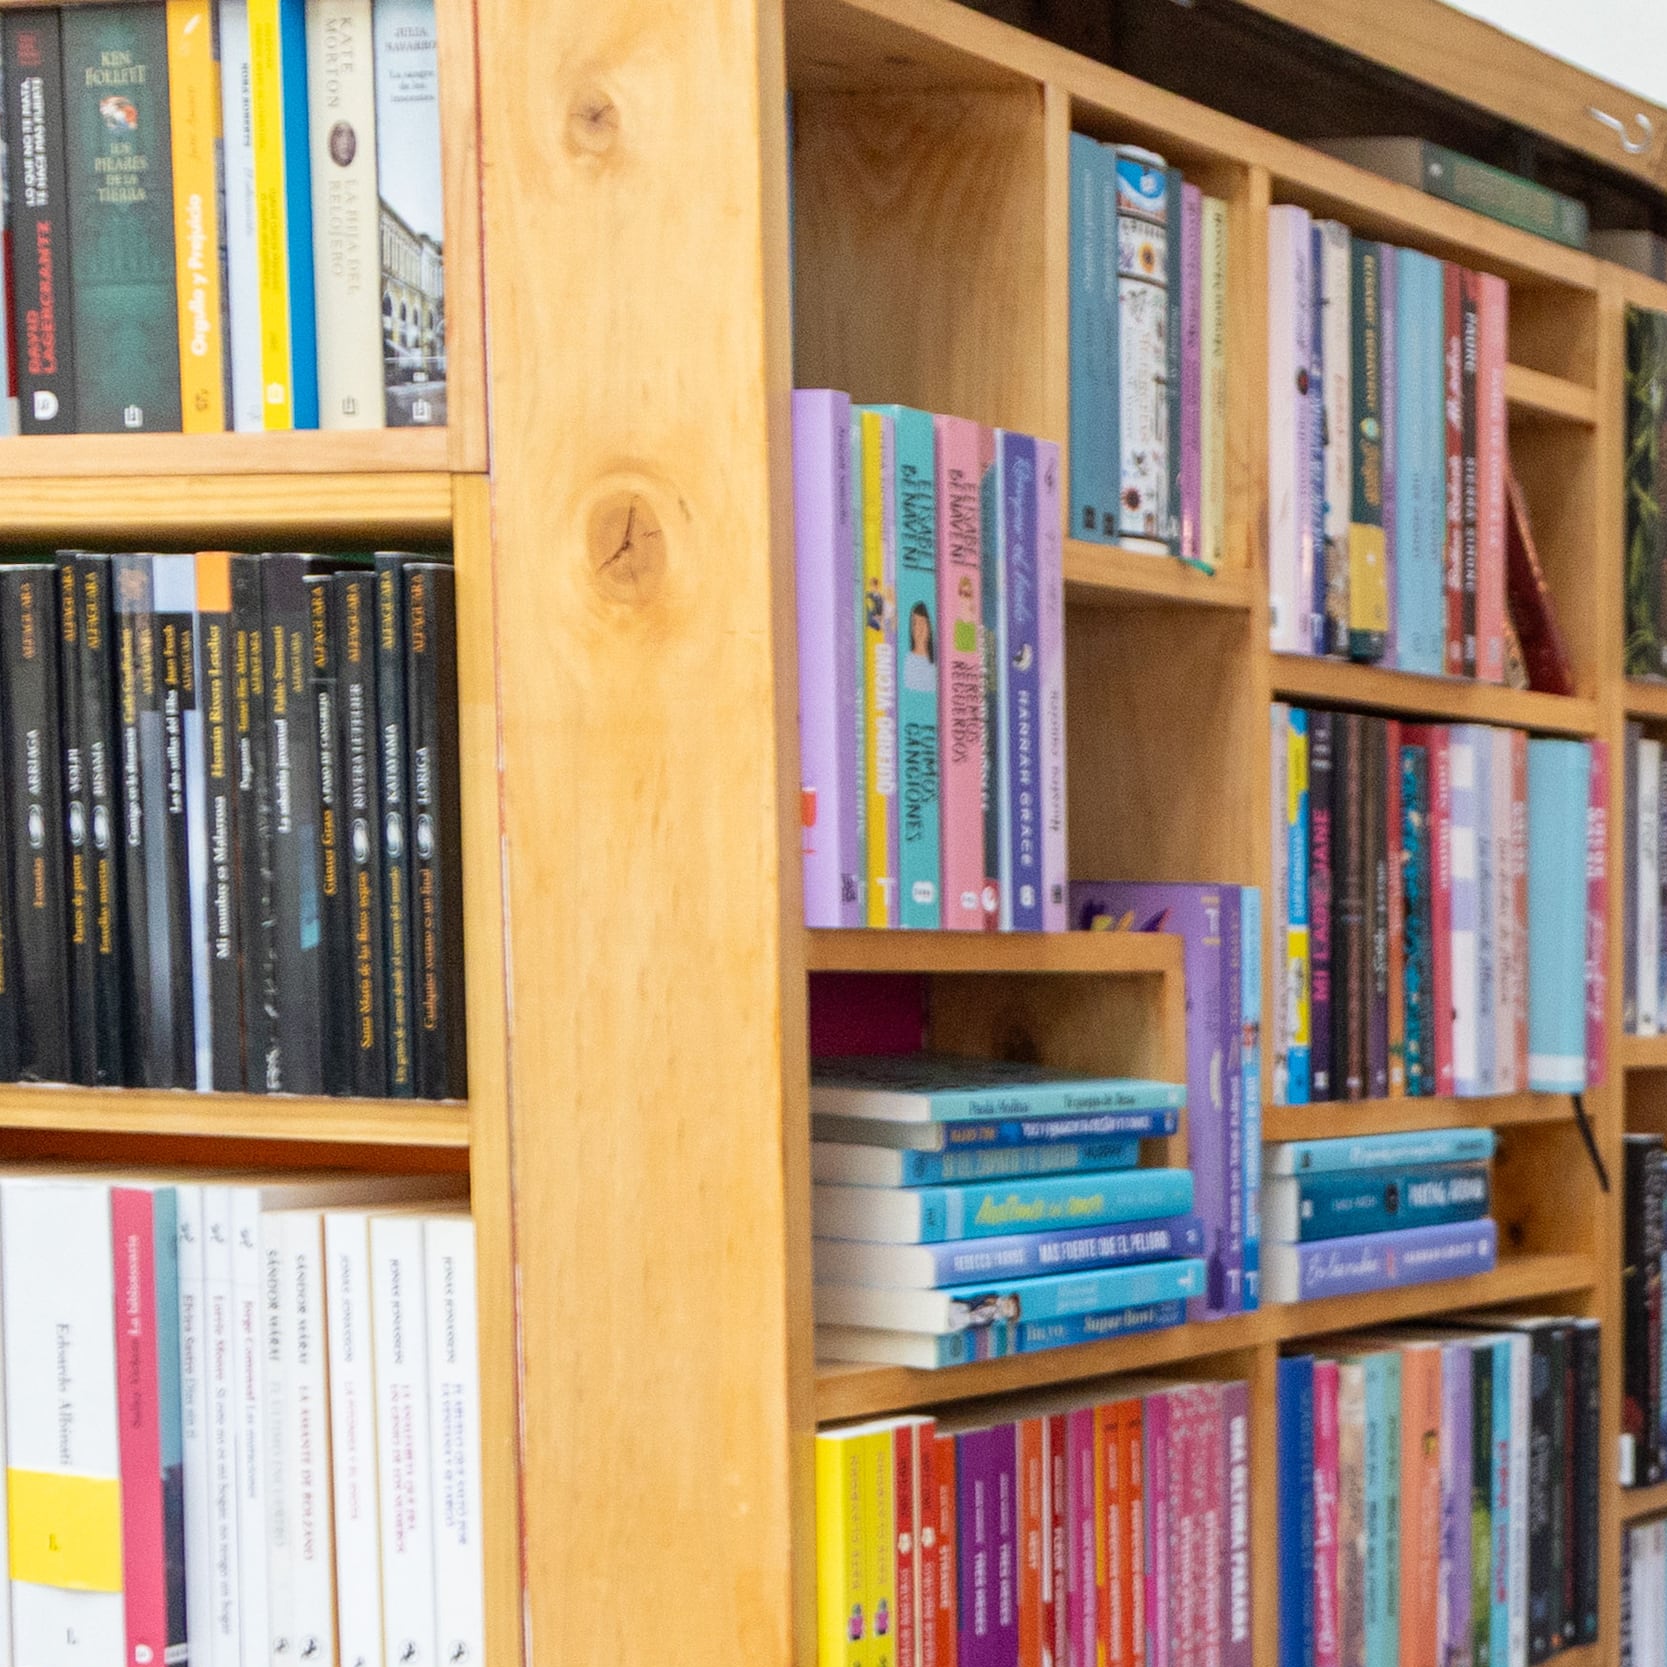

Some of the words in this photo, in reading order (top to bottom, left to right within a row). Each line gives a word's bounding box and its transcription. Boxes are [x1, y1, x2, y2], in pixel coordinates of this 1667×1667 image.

[325, 18, 340, 109] MORTON
[339, 16, 354, 74] KATE
[187, 289, 211, 356] Orgullo
[20, 582, 36, 659] ALFAGUARA
[61, 565, 78, 643] ALFAGUARA
[84, 571, 100, 651] ALFAGUARA
[311, 586, 328, 669] ALFAGUARA
[345, 583, 361, 663] ALFAGUARA
[380, 570, 395, 650] ALFAGUARA
[410, 573, 427, 655] ALFAGUARA
[208, 679, 224, 723] Rivera
[951, 660, 968, 763] RECUERDOS
[965, 664, 980, 743] SEREMOS
[1017, 689, 1032, 785] HANNAH
[25, 729, 41, 796] ARRIAGA
[67, 747, 83, 793] VOLPI
[90, 741, 106, 797] BISAMA
[350, 753, 367, 809] RIVERA
[384, 723, 400, 804] KATAYAMA
[415, 746, 431, 807] LORIGA
[904, 722, 923, 842] CANCIONES
[918, 724, 939, 802] FUIMOS
[1018, 791, 1034, 867] GRACE
[1311, 808, 1329, 873] JANE
[214, 882, 230, 937] nombre
[215, 937, 230, 959] Mi
